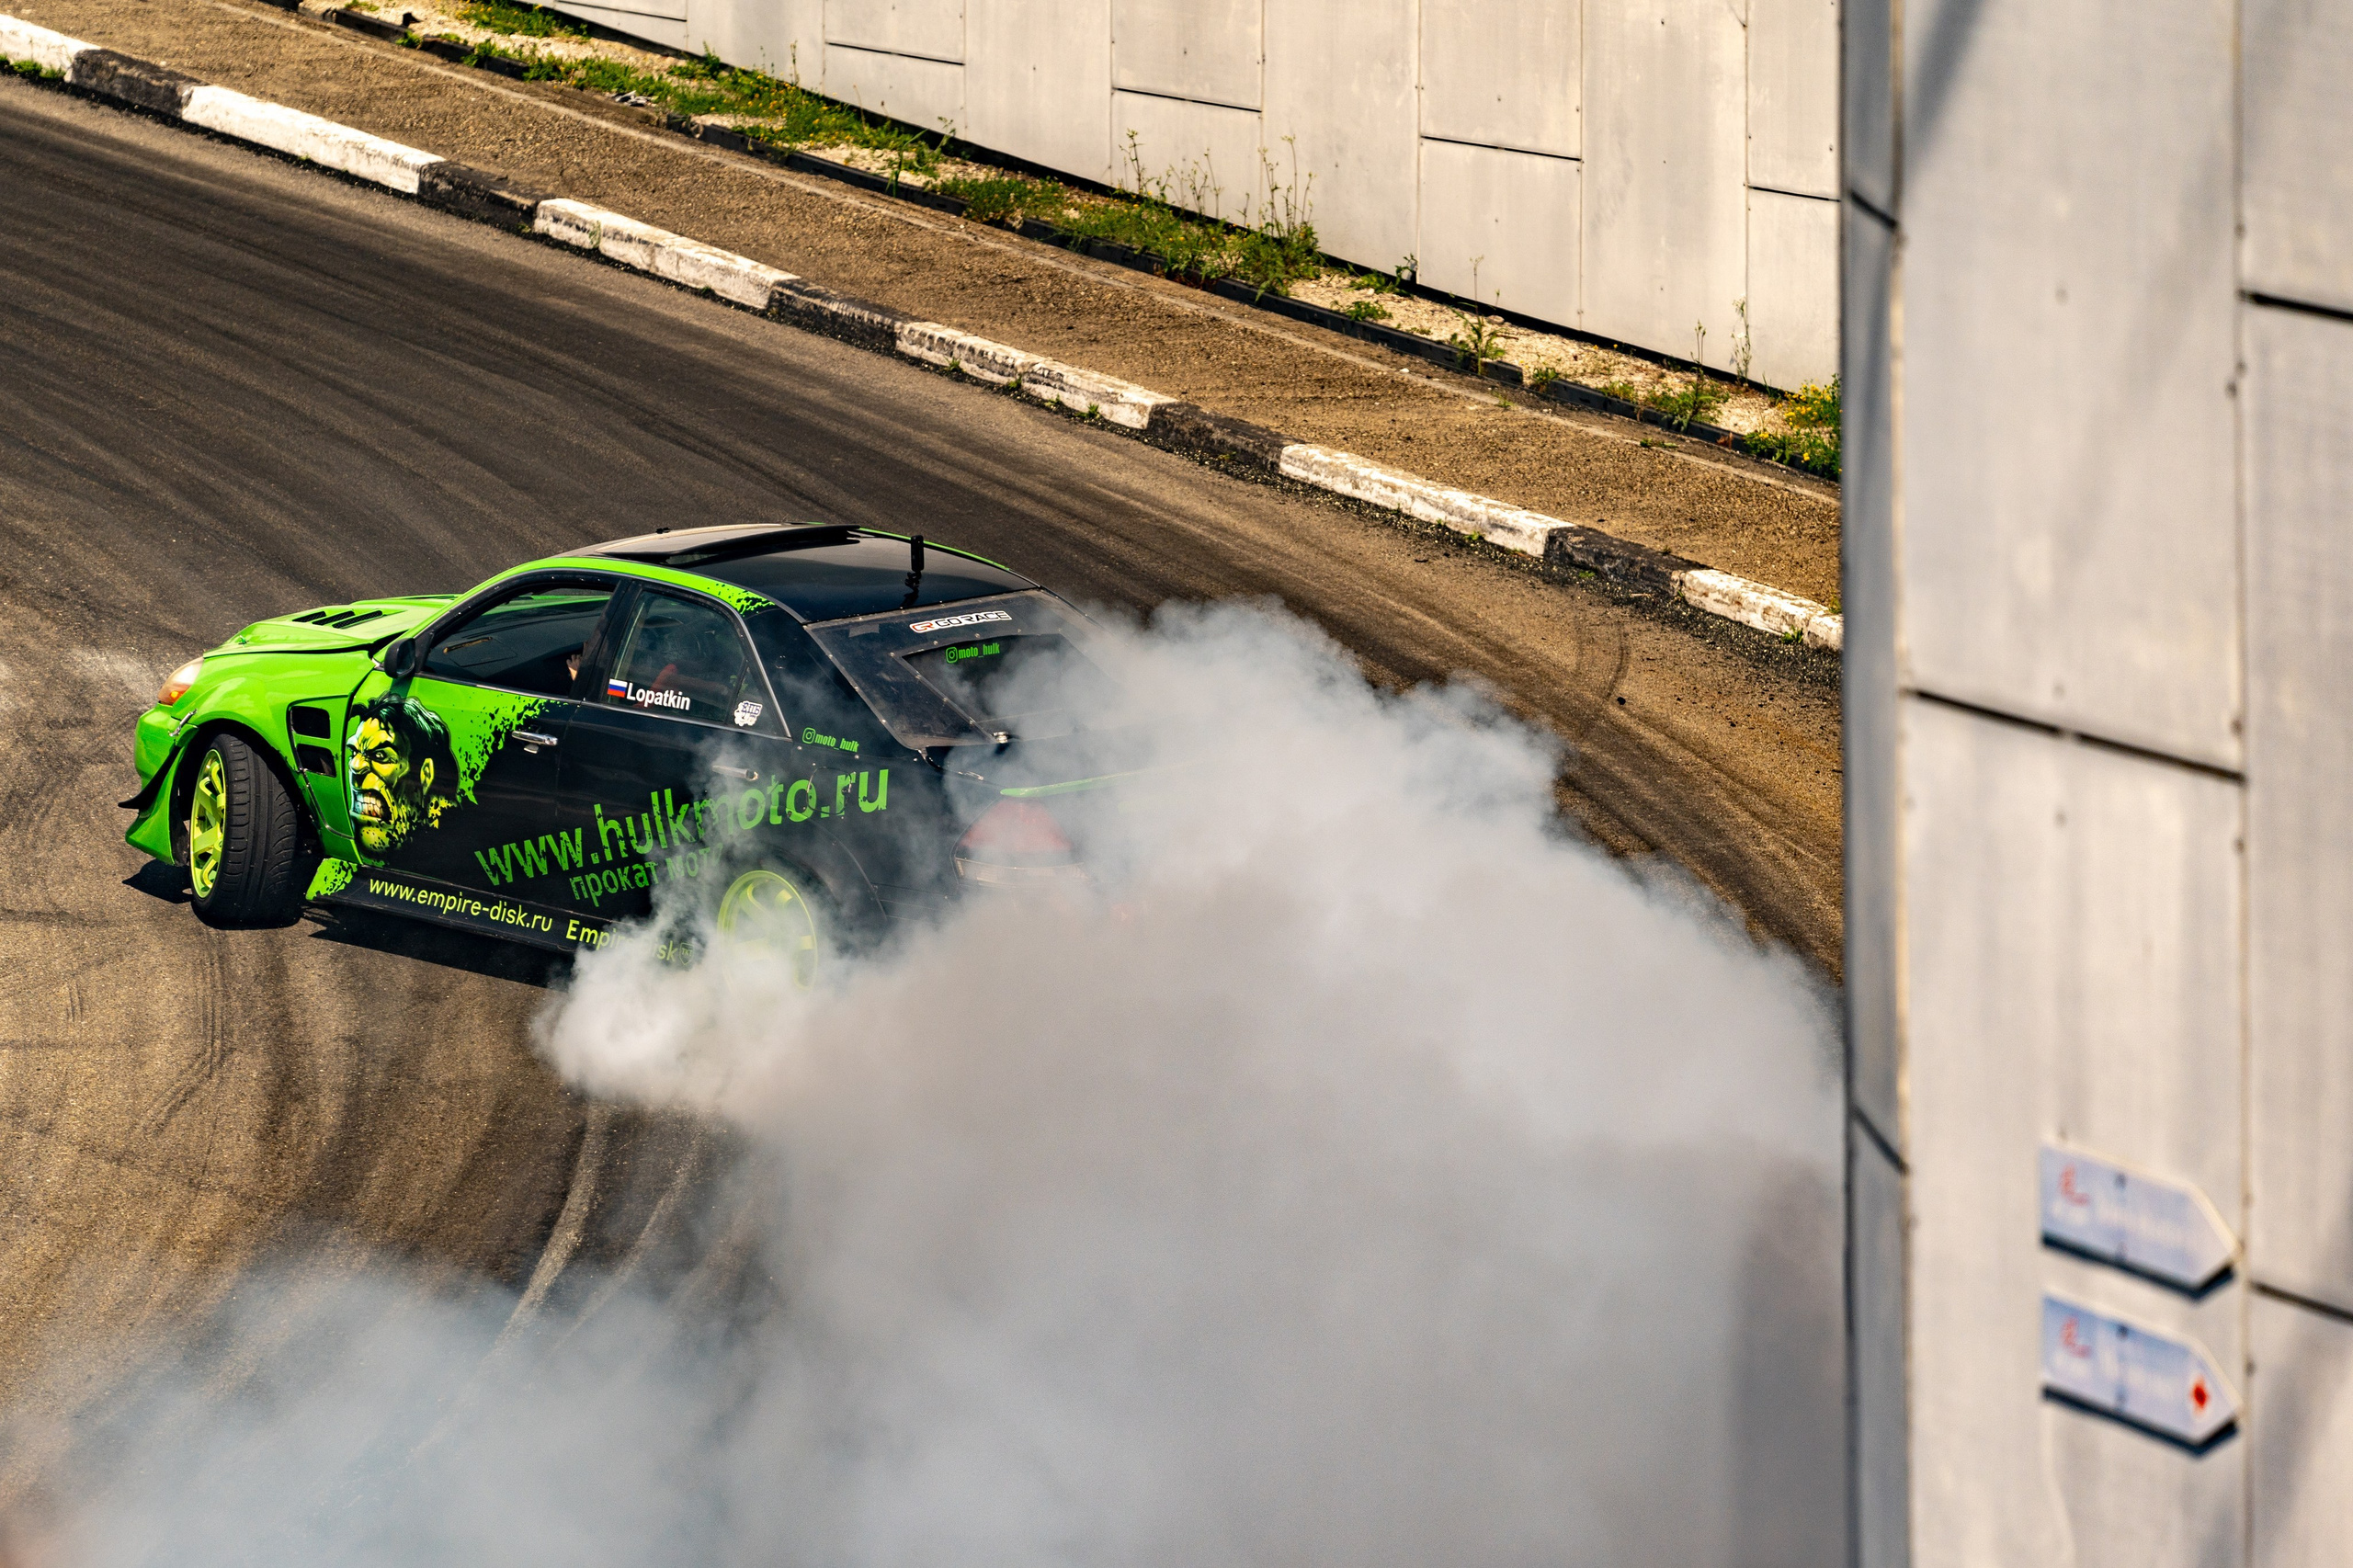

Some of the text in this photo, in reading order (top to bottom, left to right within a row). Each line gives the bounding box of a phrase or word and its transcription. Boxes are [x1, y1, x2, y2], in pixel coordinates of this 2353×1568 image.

[959, 642, 1001, 659] moto_hulk
[626, 682, 691, 711] Lopatkin
[814, 733, 859, 753] moto_hulk
[474, 768, 889, 887] www.hulkmoto.ru
[569, 860, 659, 908] прокат
[369, 878, 553, 933] www.empire-disk.ru
